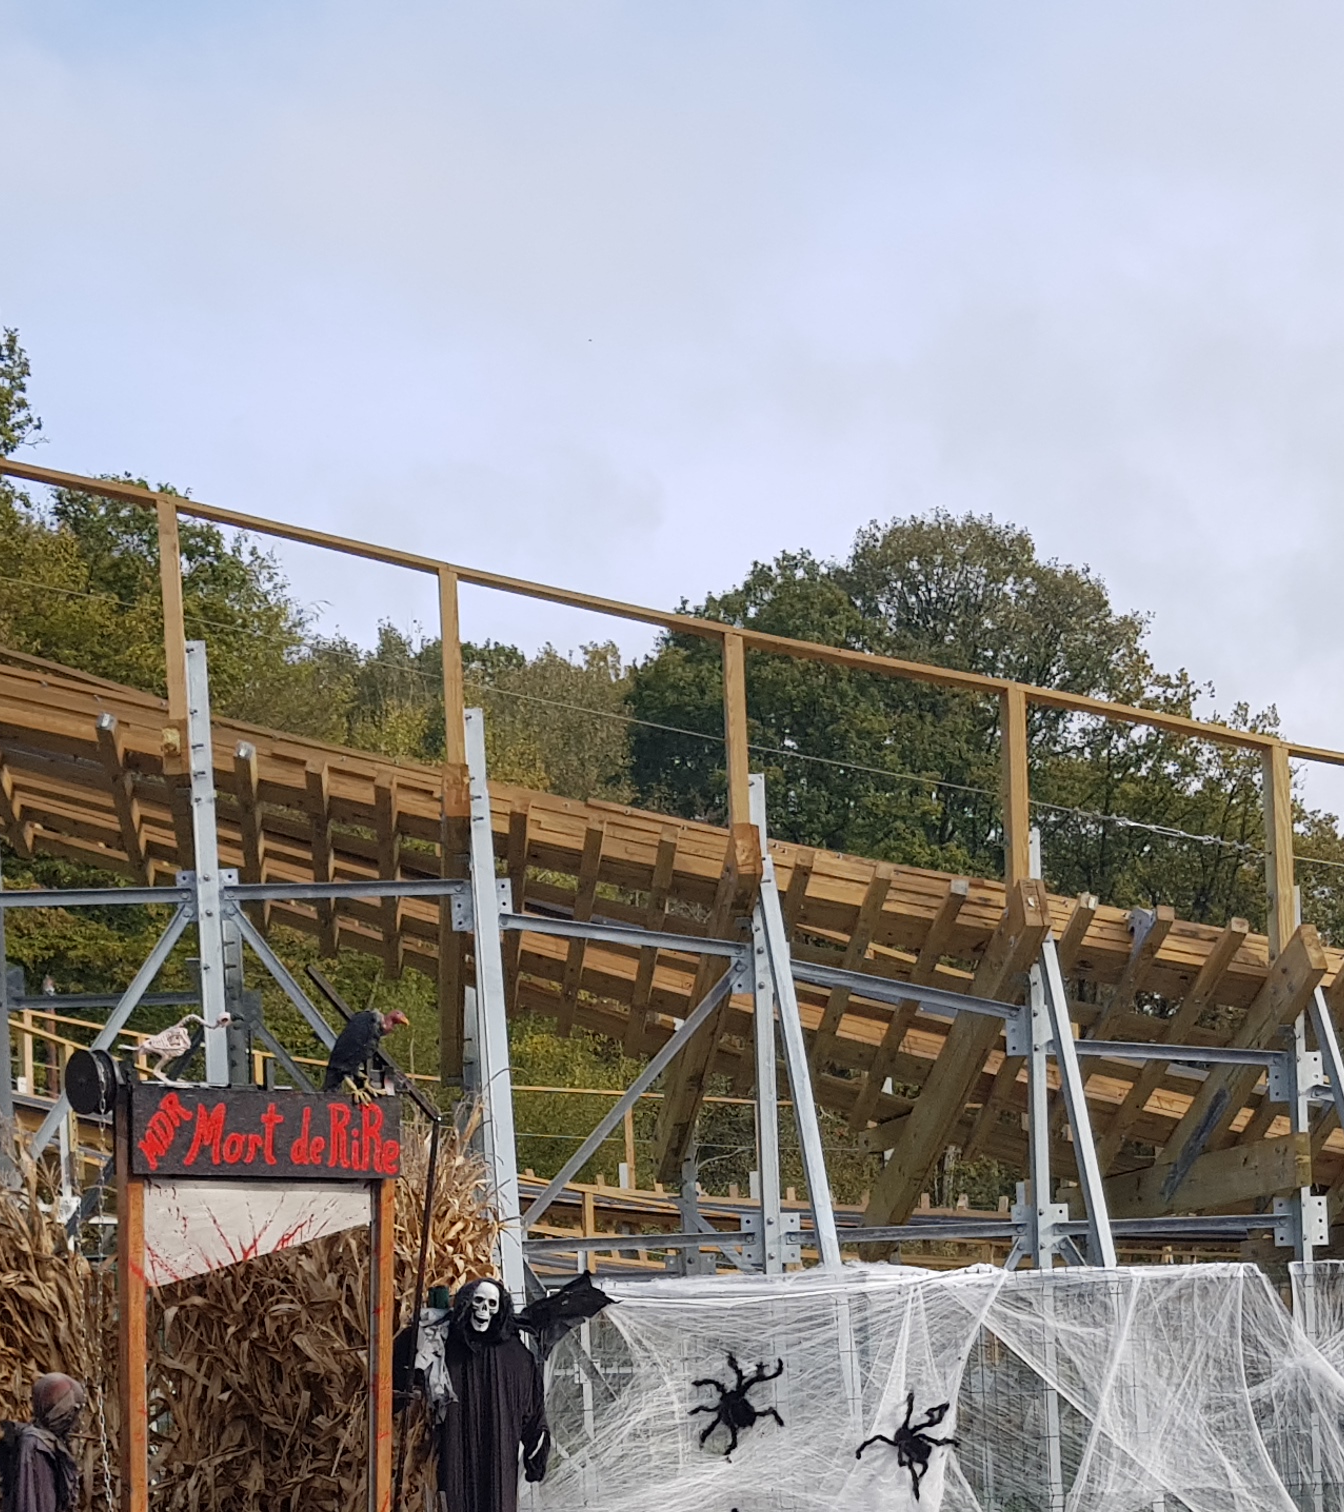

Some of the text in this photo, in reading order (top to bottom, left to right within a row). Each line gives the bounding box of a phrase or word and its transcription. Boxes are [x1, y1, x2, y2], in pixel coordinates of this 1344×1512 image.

[138, 1092, 193, 1171] MDR
[183, 1102, 284, 1166] Mort
[290, 1106, 325, 1165] de
